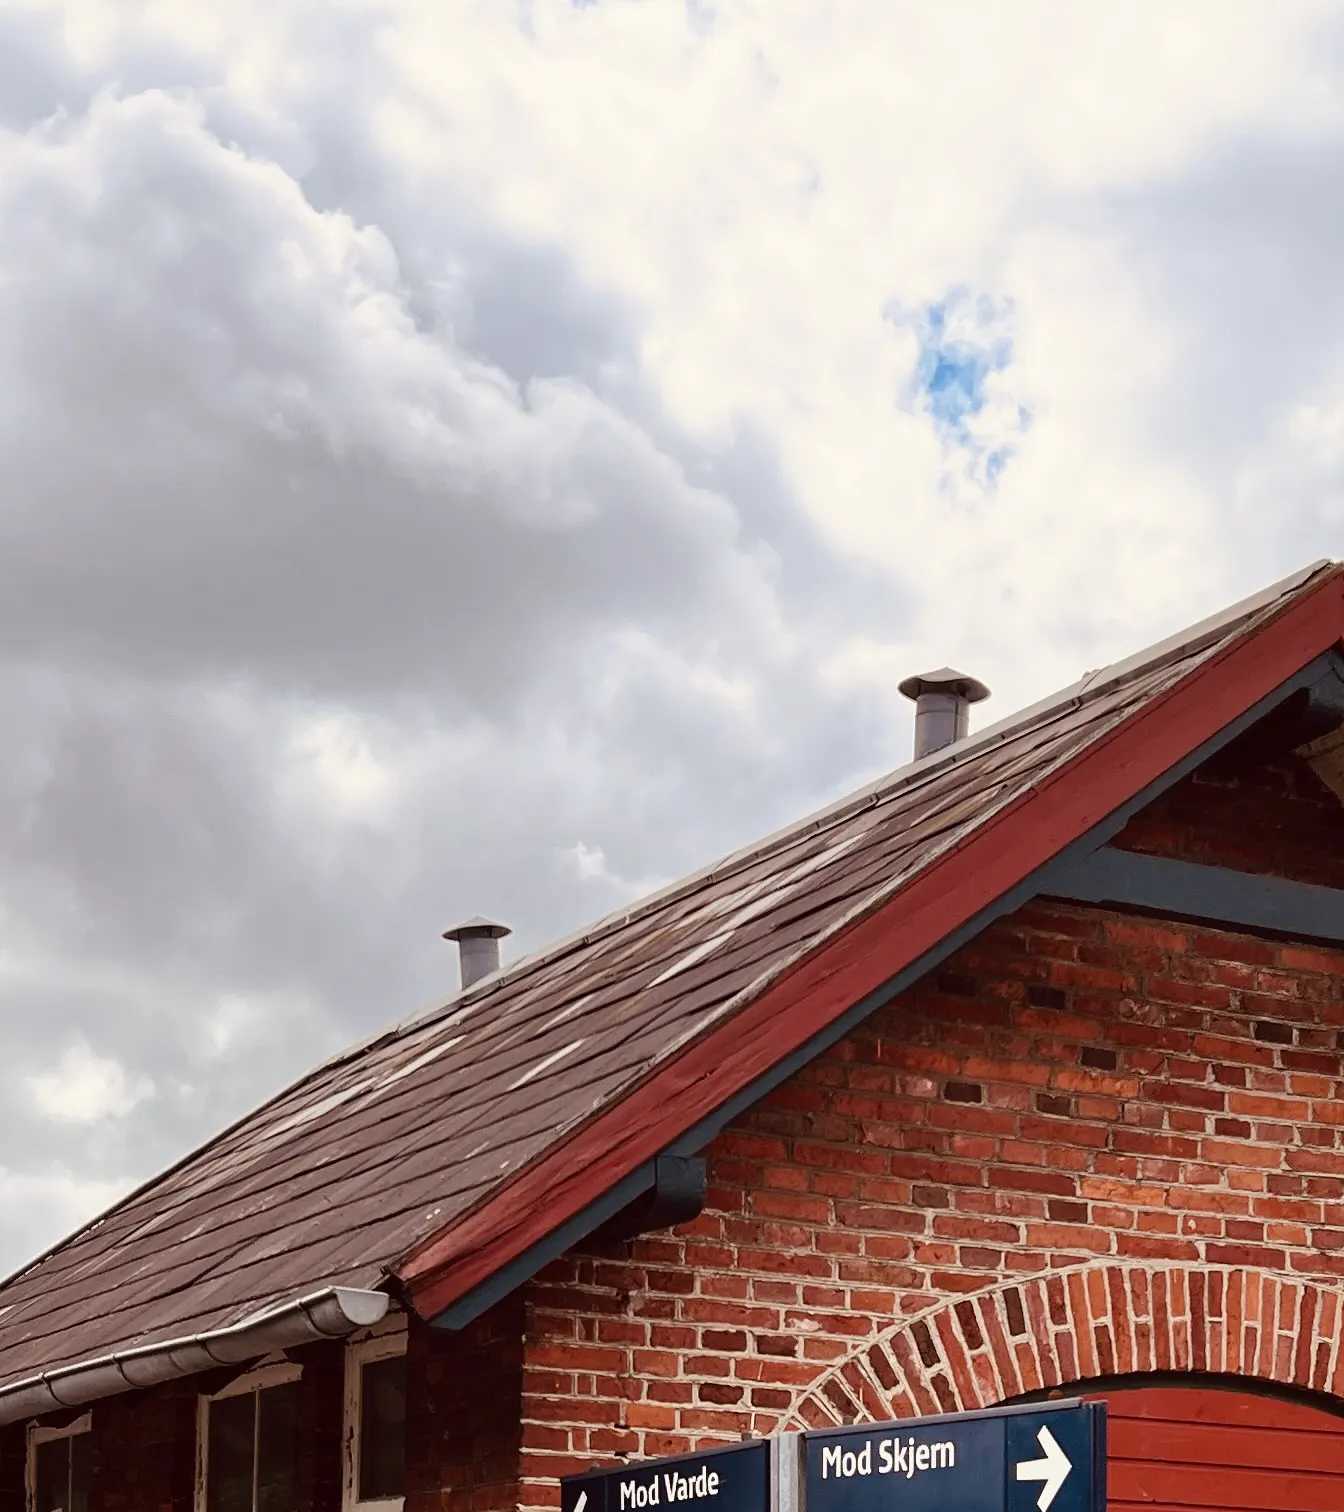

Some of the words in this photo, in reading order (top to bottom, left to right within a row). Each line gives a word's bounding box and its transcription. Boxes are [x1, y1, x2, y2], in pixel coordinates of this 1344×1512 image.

[821, 1441, 872, 1480] Mod
[878, 1437, 955, 1479] Skjern
[620, 1473, 660, 1511] Mod
[664, 1465, 720, 1501] Varde
